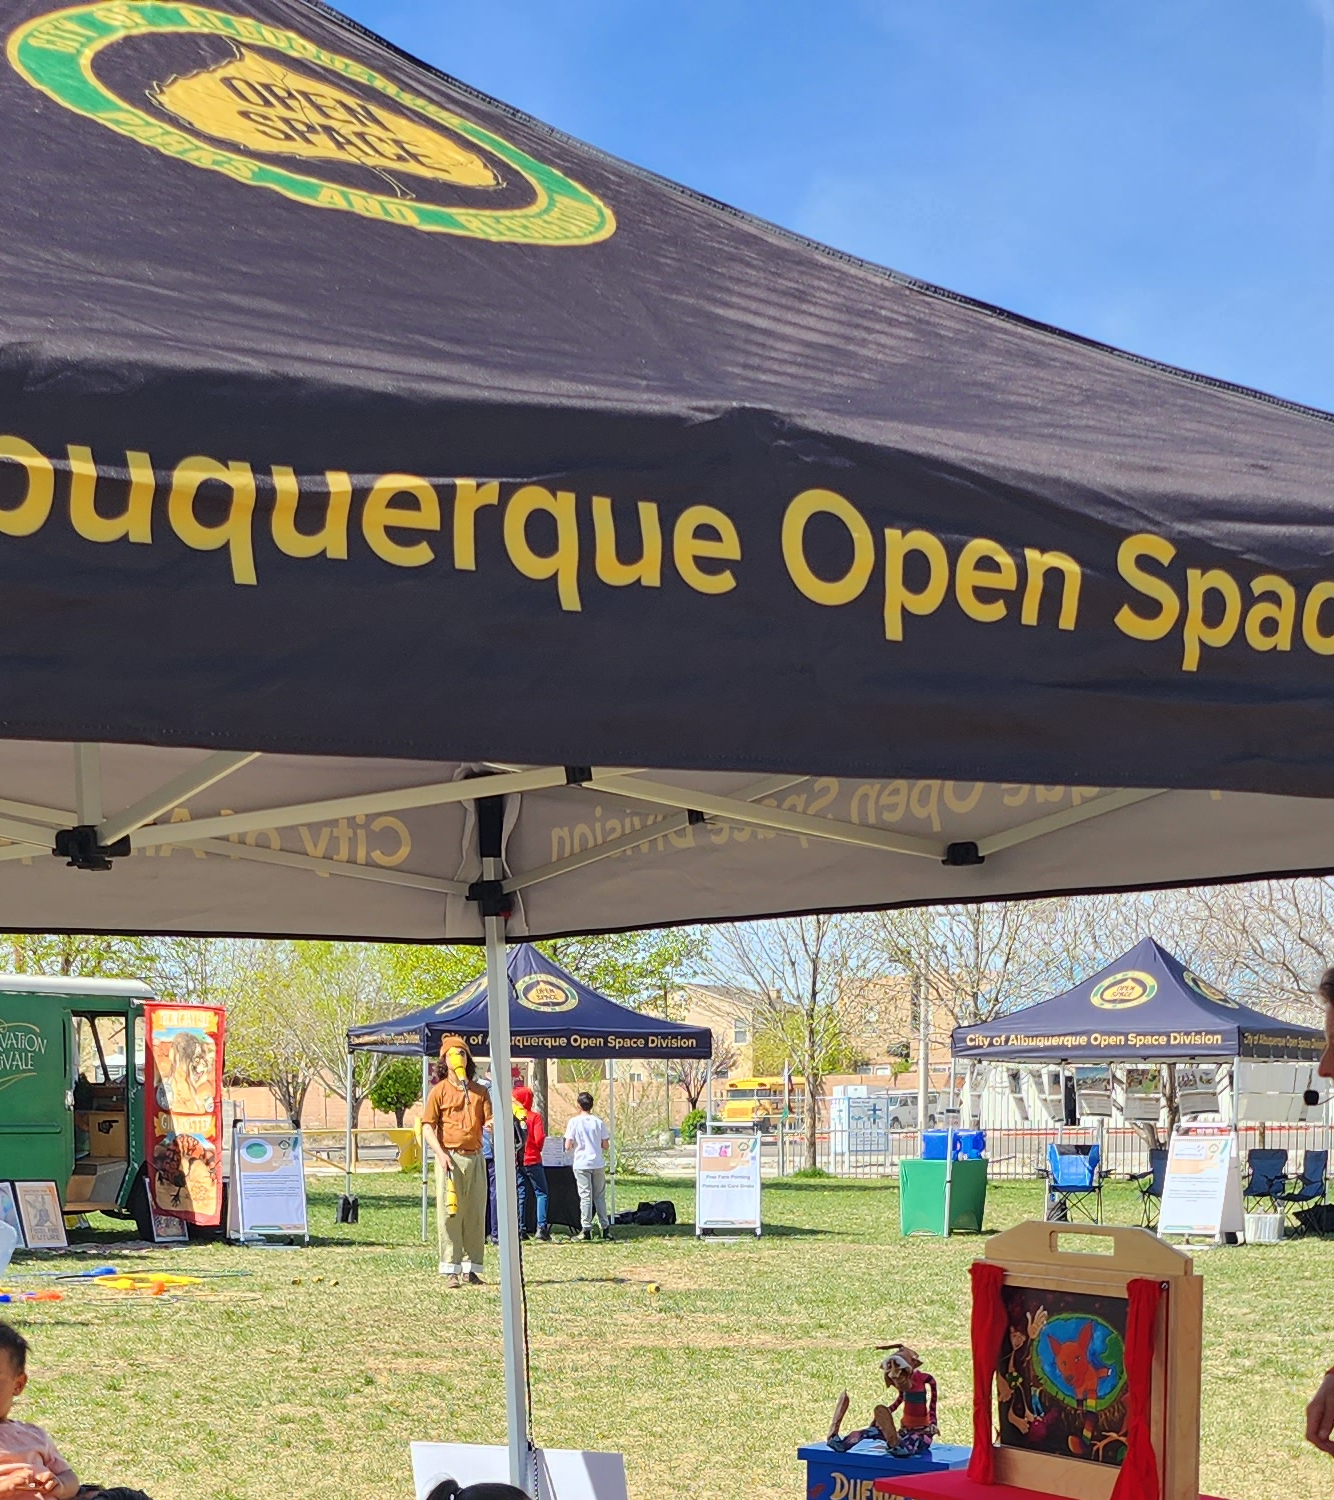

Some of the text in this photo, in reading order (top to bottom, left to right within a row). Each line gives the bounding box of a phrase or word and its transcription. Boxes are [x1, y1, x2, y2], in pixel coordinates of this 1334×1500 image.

[221, 75, 388, 134] OPEN
[235, 109, 451, 174] SPACE
[317, 186, 420, 225] AND
[781, 488, 1082, 641] Open
[469, 1033, 483, 1045] of
[570, 1034, 604, 1049] Open
[607, 1035, 644, 1050] Space
[648, 1035, 697, 1048] Division
[966, 1032, 1222, 1048] City of Albuquerque Open Space Division
